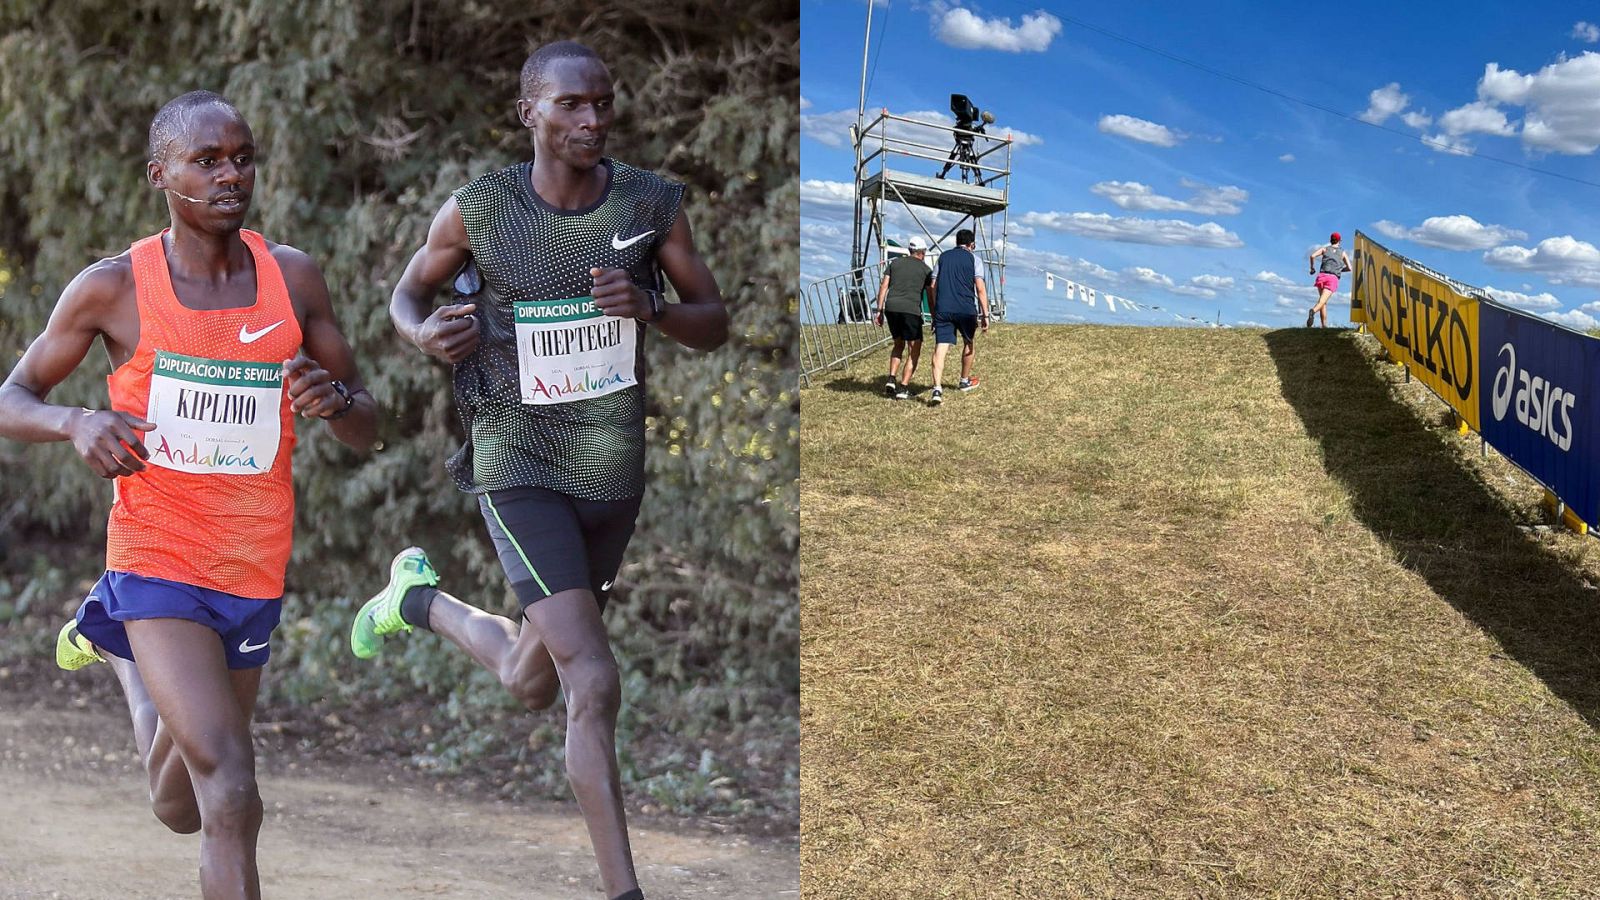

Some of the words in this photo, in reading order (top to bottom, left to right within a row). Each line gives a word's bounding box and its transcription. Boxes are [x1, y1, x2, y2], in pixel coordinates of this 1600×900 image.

[518, 304, 580, 318] DIPUTACION
[582, 302, 595, 314] DE
[531, 319, 621, 357] CHEPTEGEI
[1381, 266, 1473, 401] SEIKO
[158, 357, 226, 379] DIPUTACION
[228, 367, 241, 380] DE
[244, 367, 280, 382] SEVILLA
[529, 366, 625, 400] Andalucía
[175, 388, 256, 425] KIPLIMO
[1515, 369, 1575, 452] asics
[154, 434, 260, 470] Andalucía
